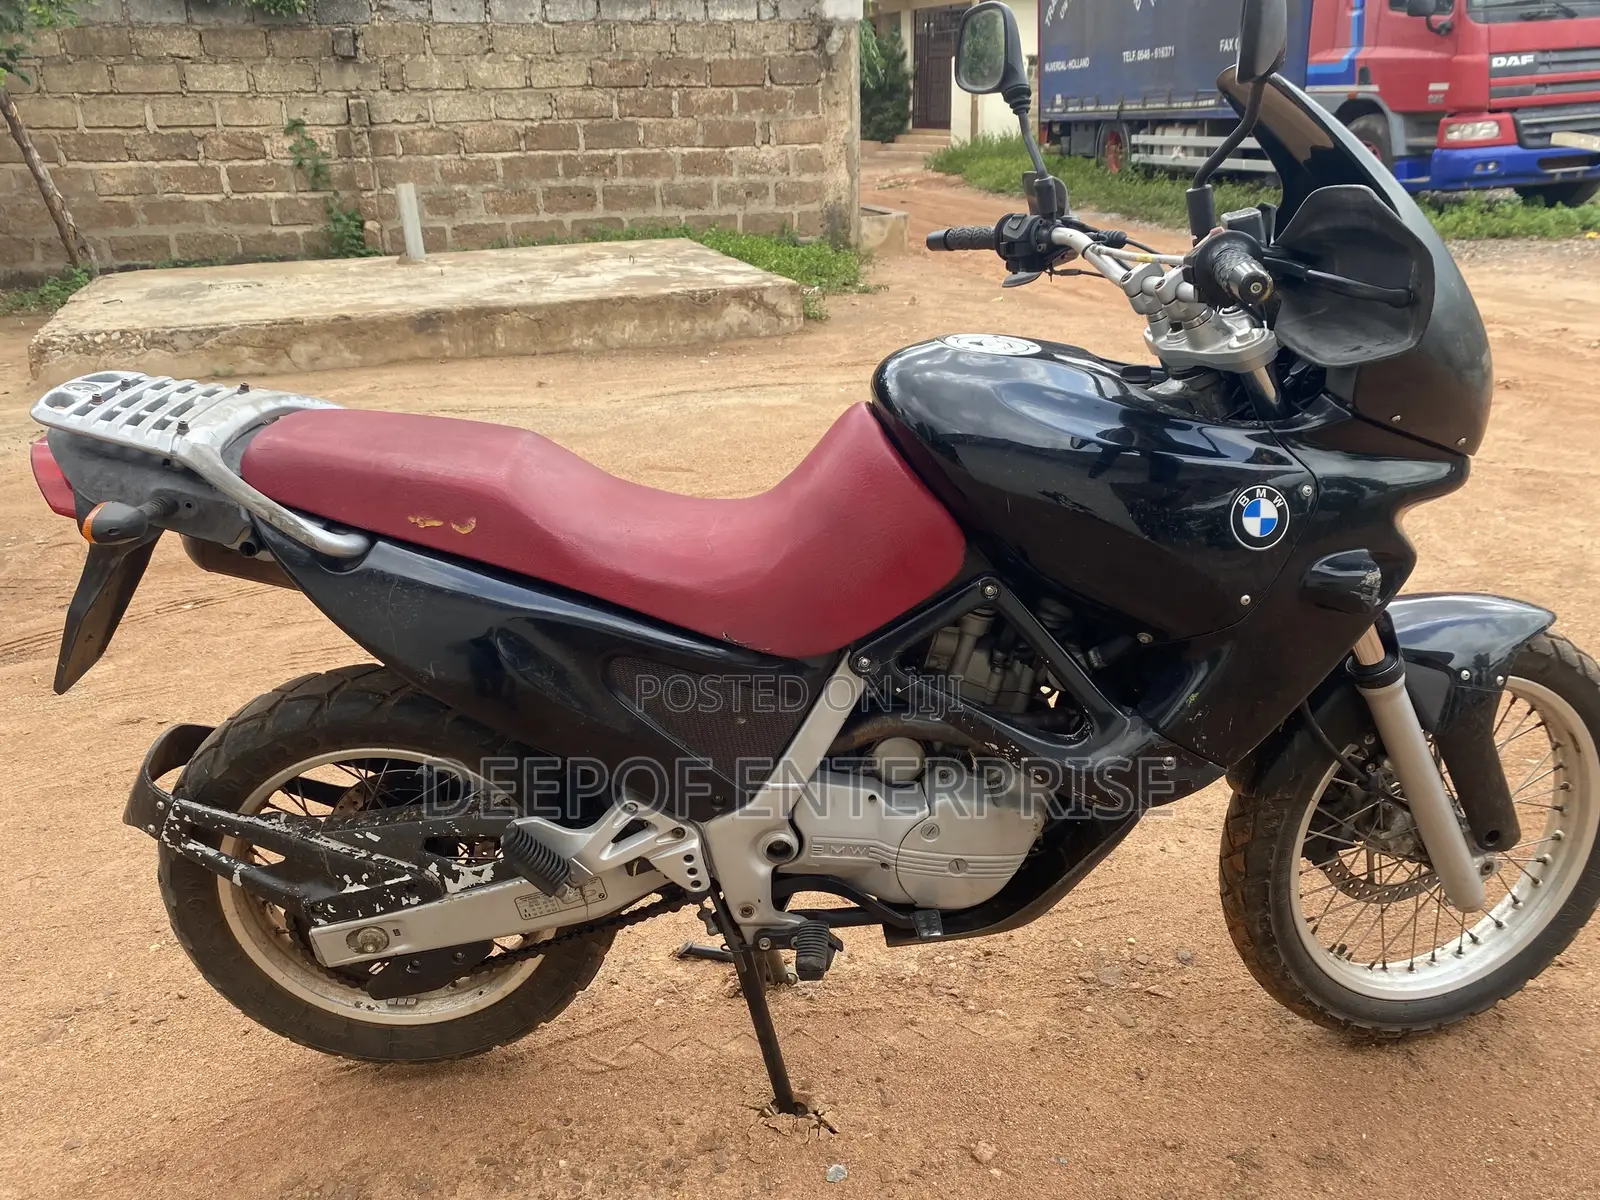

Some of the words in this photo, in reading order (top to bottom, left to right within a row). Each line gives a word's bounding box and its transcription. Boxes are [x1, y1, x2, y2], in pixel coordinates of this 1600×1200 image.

[1220, 38, 1234, 52] FAX
[1491, 54, 1535, 69] DAF
[1238, 488, 1284, 508] BMW
